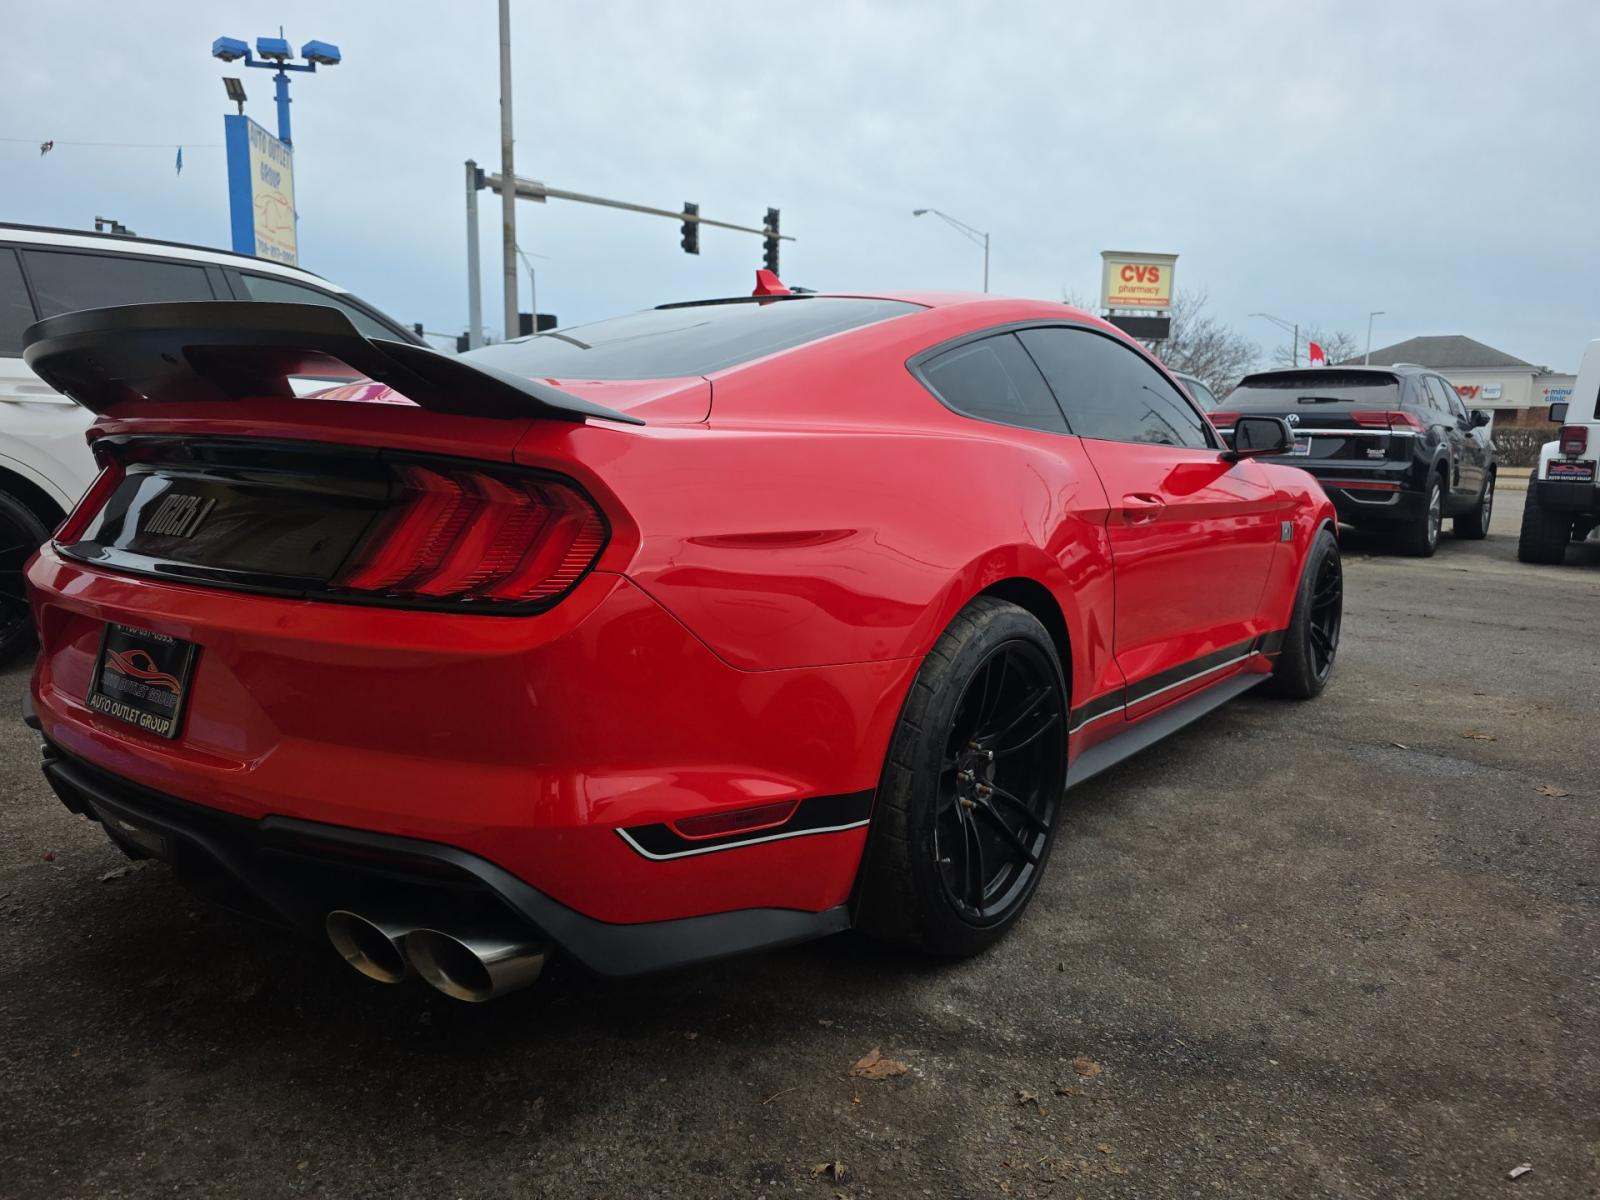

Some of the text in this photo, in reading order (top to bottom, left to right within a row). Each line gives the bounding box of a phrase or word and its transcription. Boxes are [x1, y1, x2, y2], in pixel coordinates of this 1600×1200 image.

[249, 125, 267, 155] AUTO
[1120, 265, 1160, 284] CVS
[1118, 285, 1160, 295] pharmacy
[90, 695, 170, 734] AUTO OUTLET GROUP
